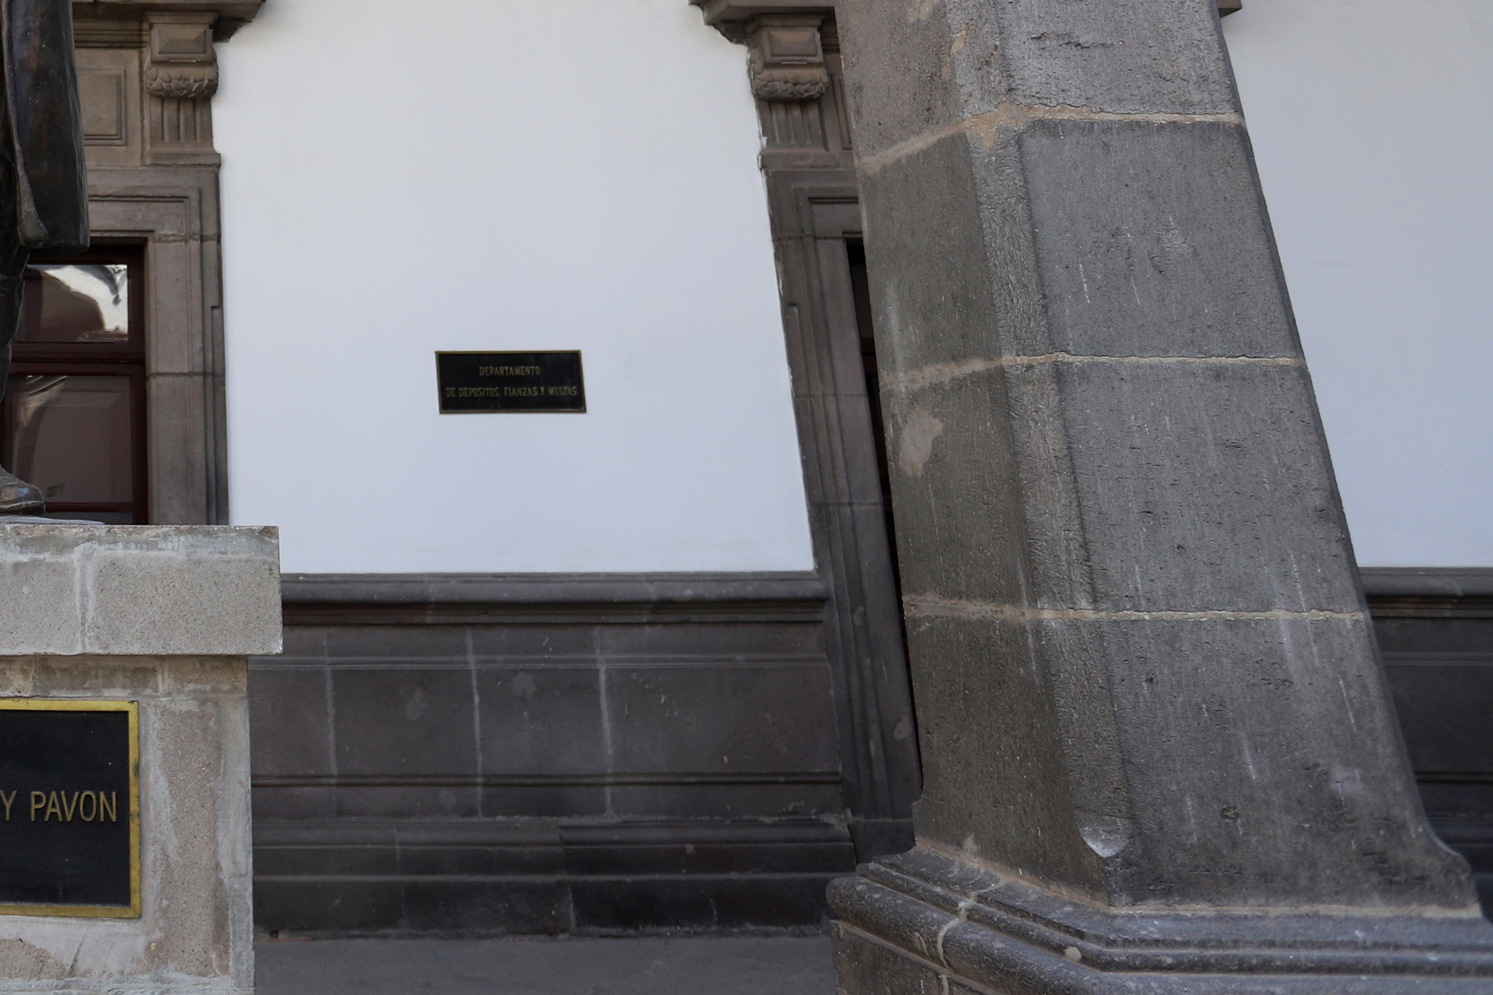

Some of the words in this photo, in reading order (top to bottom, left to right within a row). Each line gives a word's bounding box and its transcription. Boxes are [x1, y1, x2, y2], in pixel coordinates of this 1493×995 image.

[479, 365, 541, 377] DEPARTAMENTO
[445, 387, 456, 398] DE
[504, 386, 538, 397] FIANZAS
[539, 387, 545, 396] Y
[548, 386, 577, 396] MULTAS
[0, 790, 17, 822] Y
[29, 791, 117, 822] PAVON
